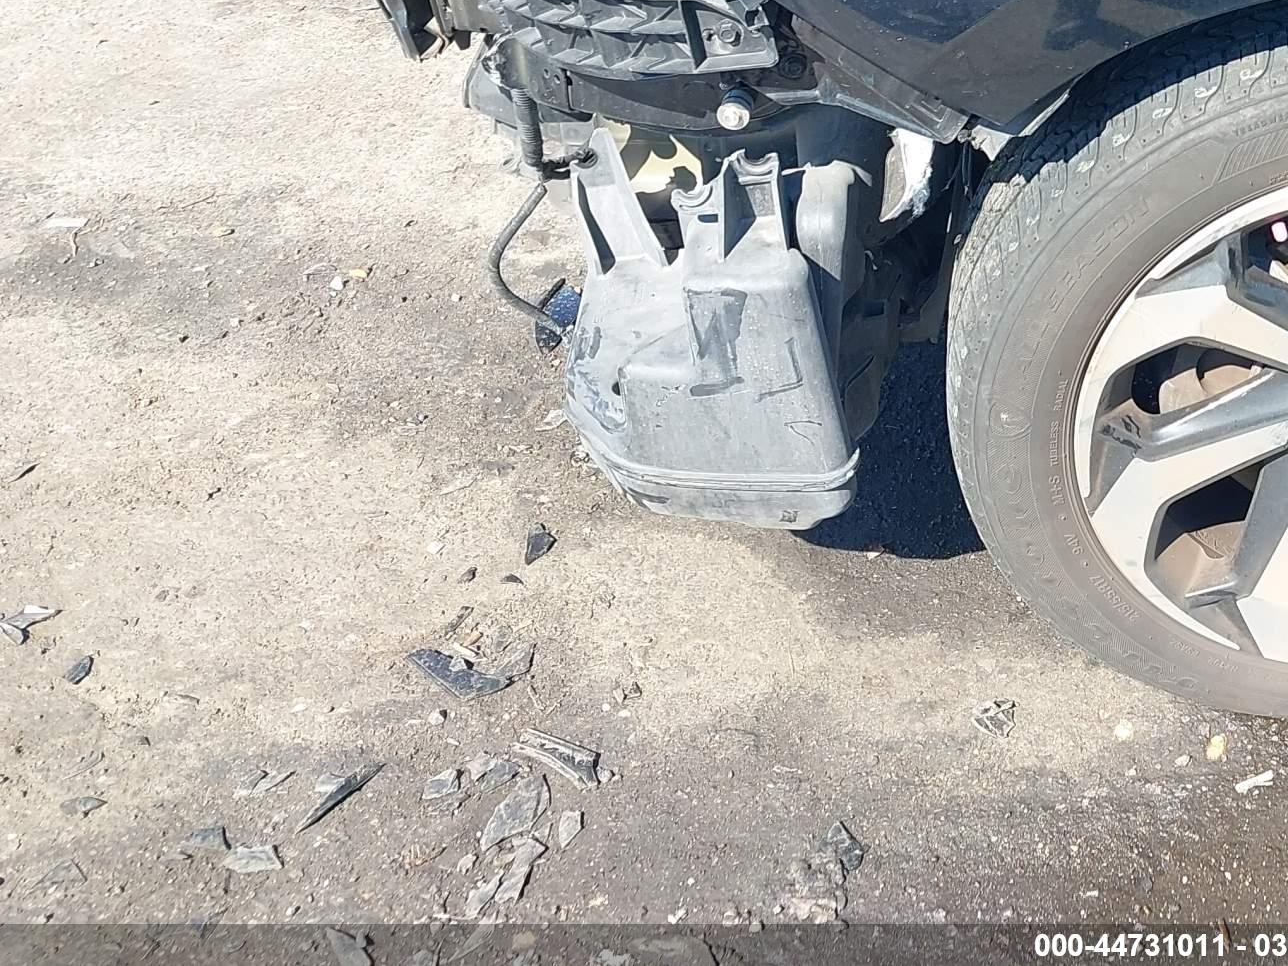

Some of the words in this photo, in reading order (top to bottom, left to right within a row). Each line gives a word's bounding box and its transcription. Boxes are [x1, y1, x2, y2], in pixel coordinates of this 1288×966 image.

[1053, 379, 1070, 412] RADIAL
[1048, 475, 1066, 507] M+S
[1063, 533, 1085, 556] 94V
